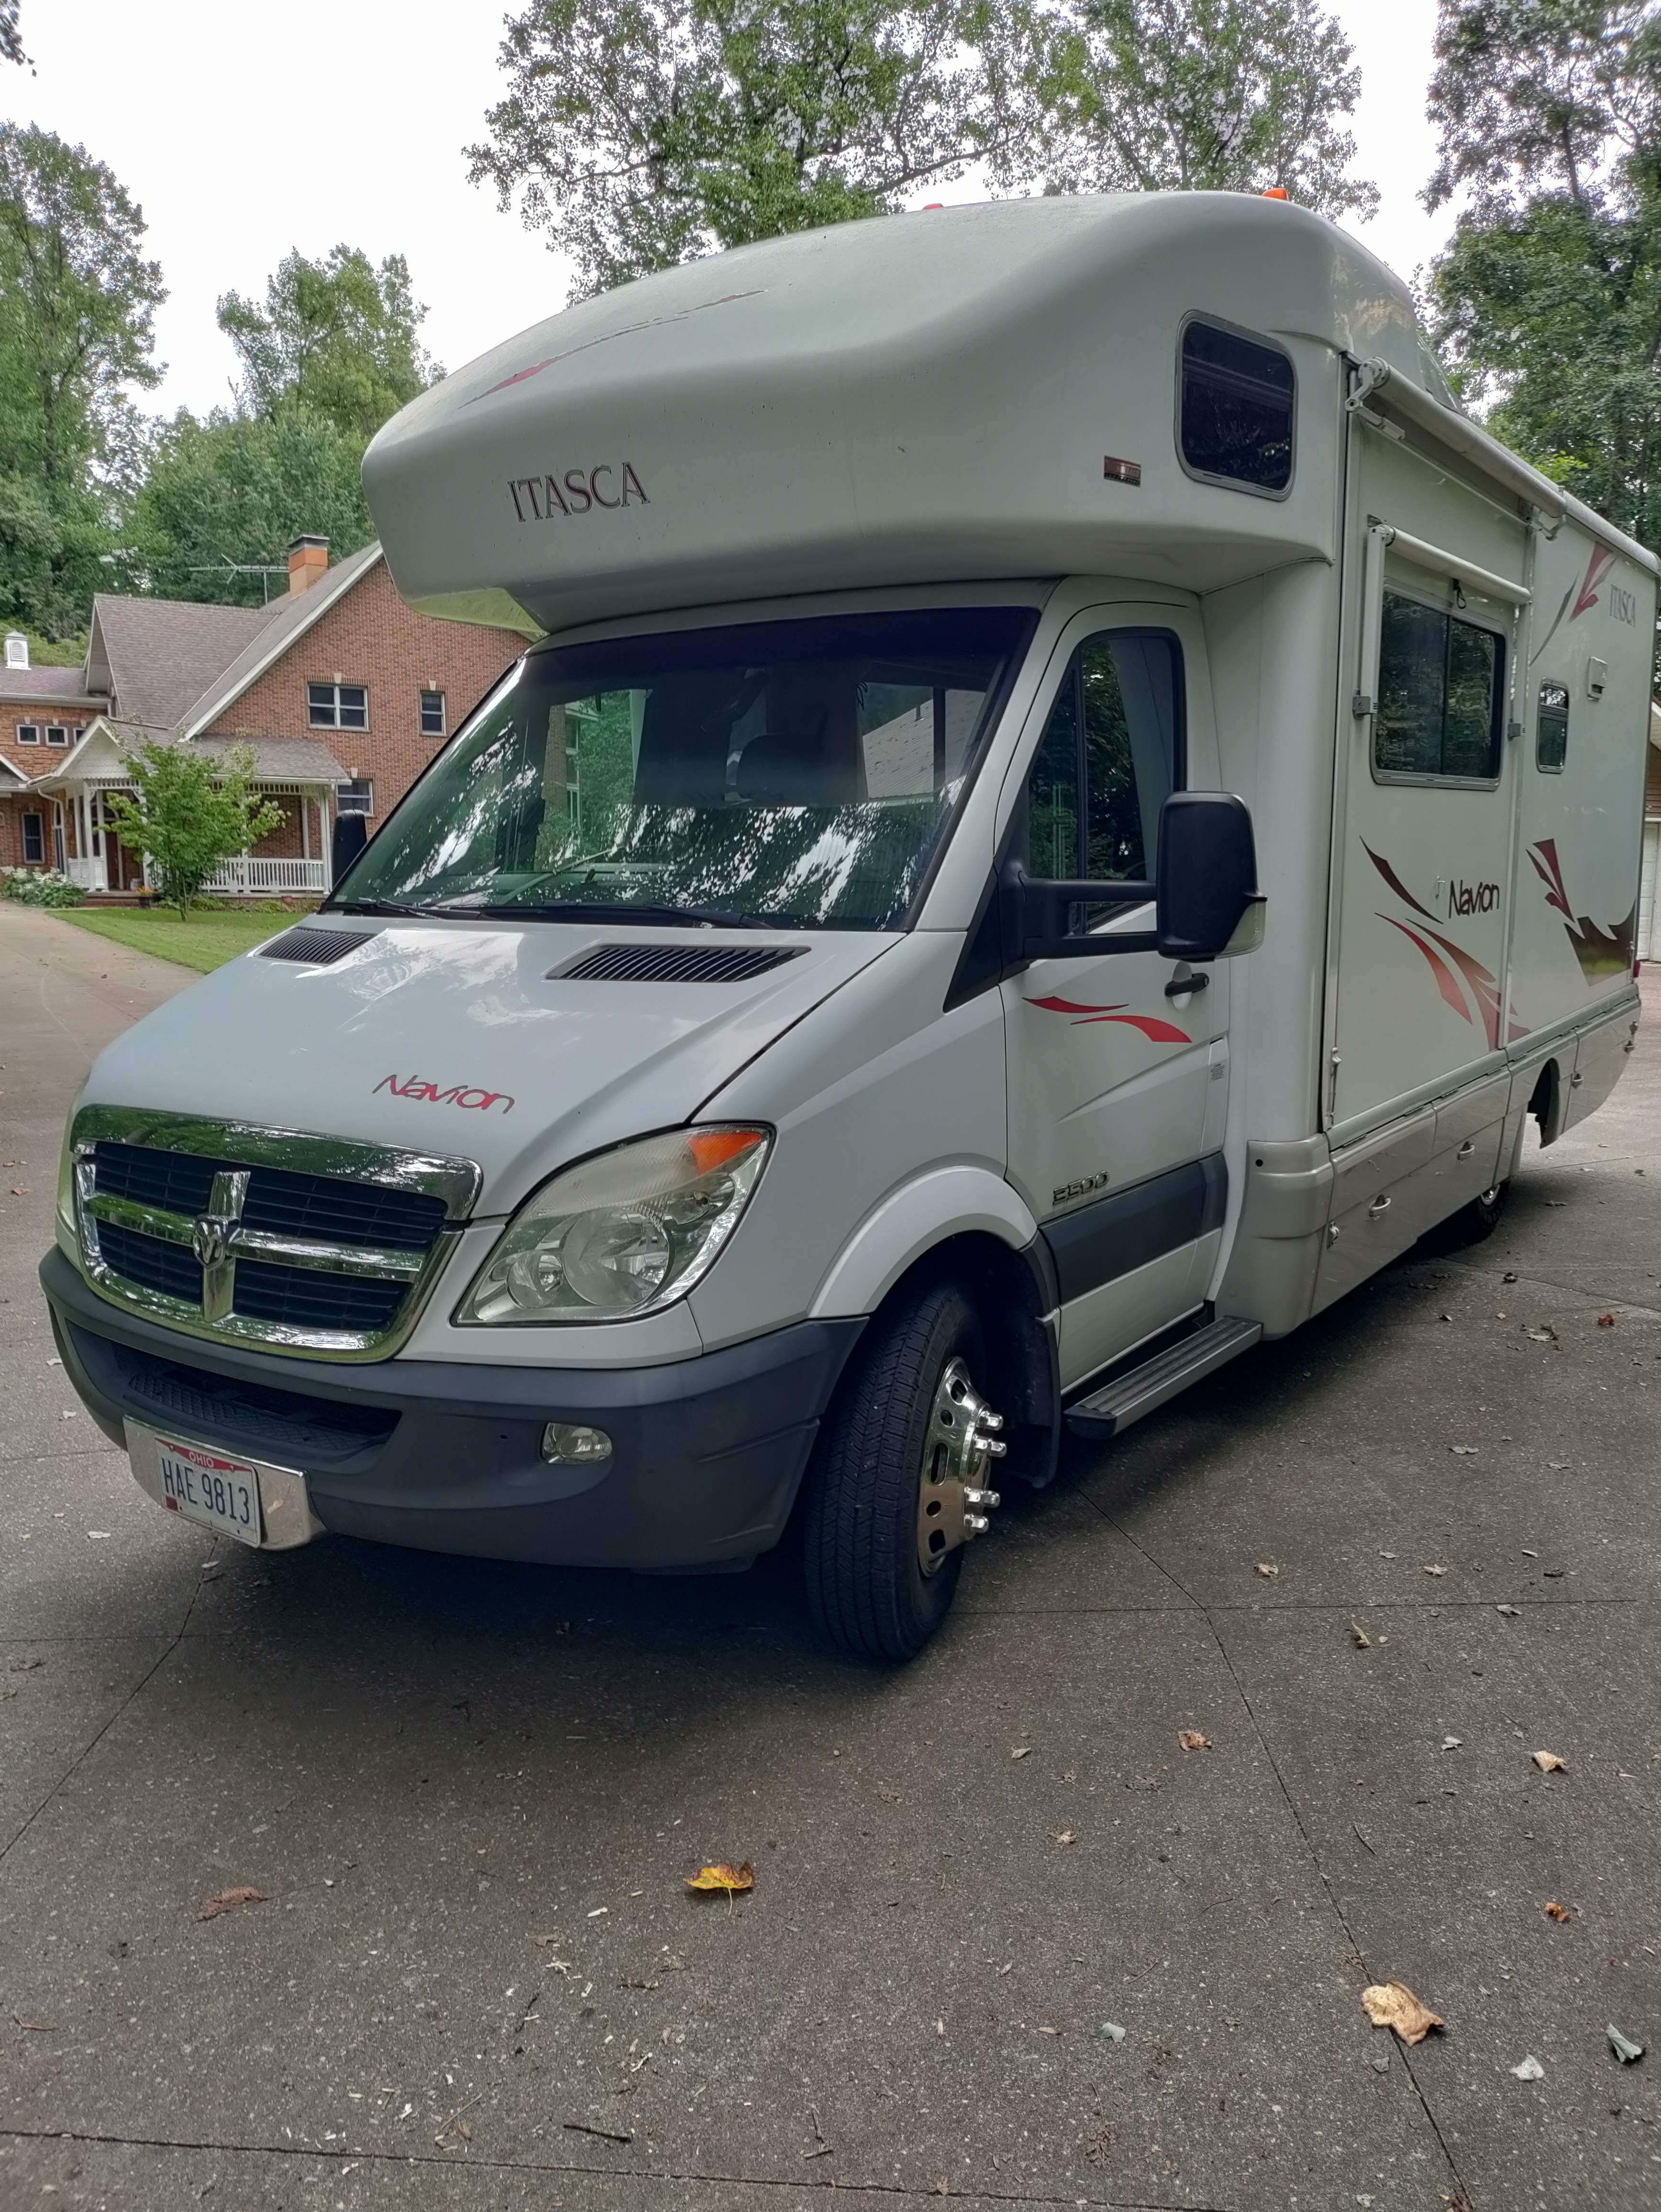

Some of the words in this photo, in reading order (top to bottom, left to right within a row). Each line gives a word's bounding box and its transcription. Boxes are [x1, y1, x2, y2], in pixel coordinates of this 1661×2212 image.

[507, 462, 650, 522] ITASCA
[1609, 584, 1636, 628] ITASCA
[1449, 879, 1499, 919] Navion
[372, 1074, 515, 1114] Navion
[1052, 1171, 1110, 1206] 3500
[188, 1451, 214, 1468] OHIO
[162, 1458, 198, 1505] HAE
[201, 1473, 249, 1524] 9813
